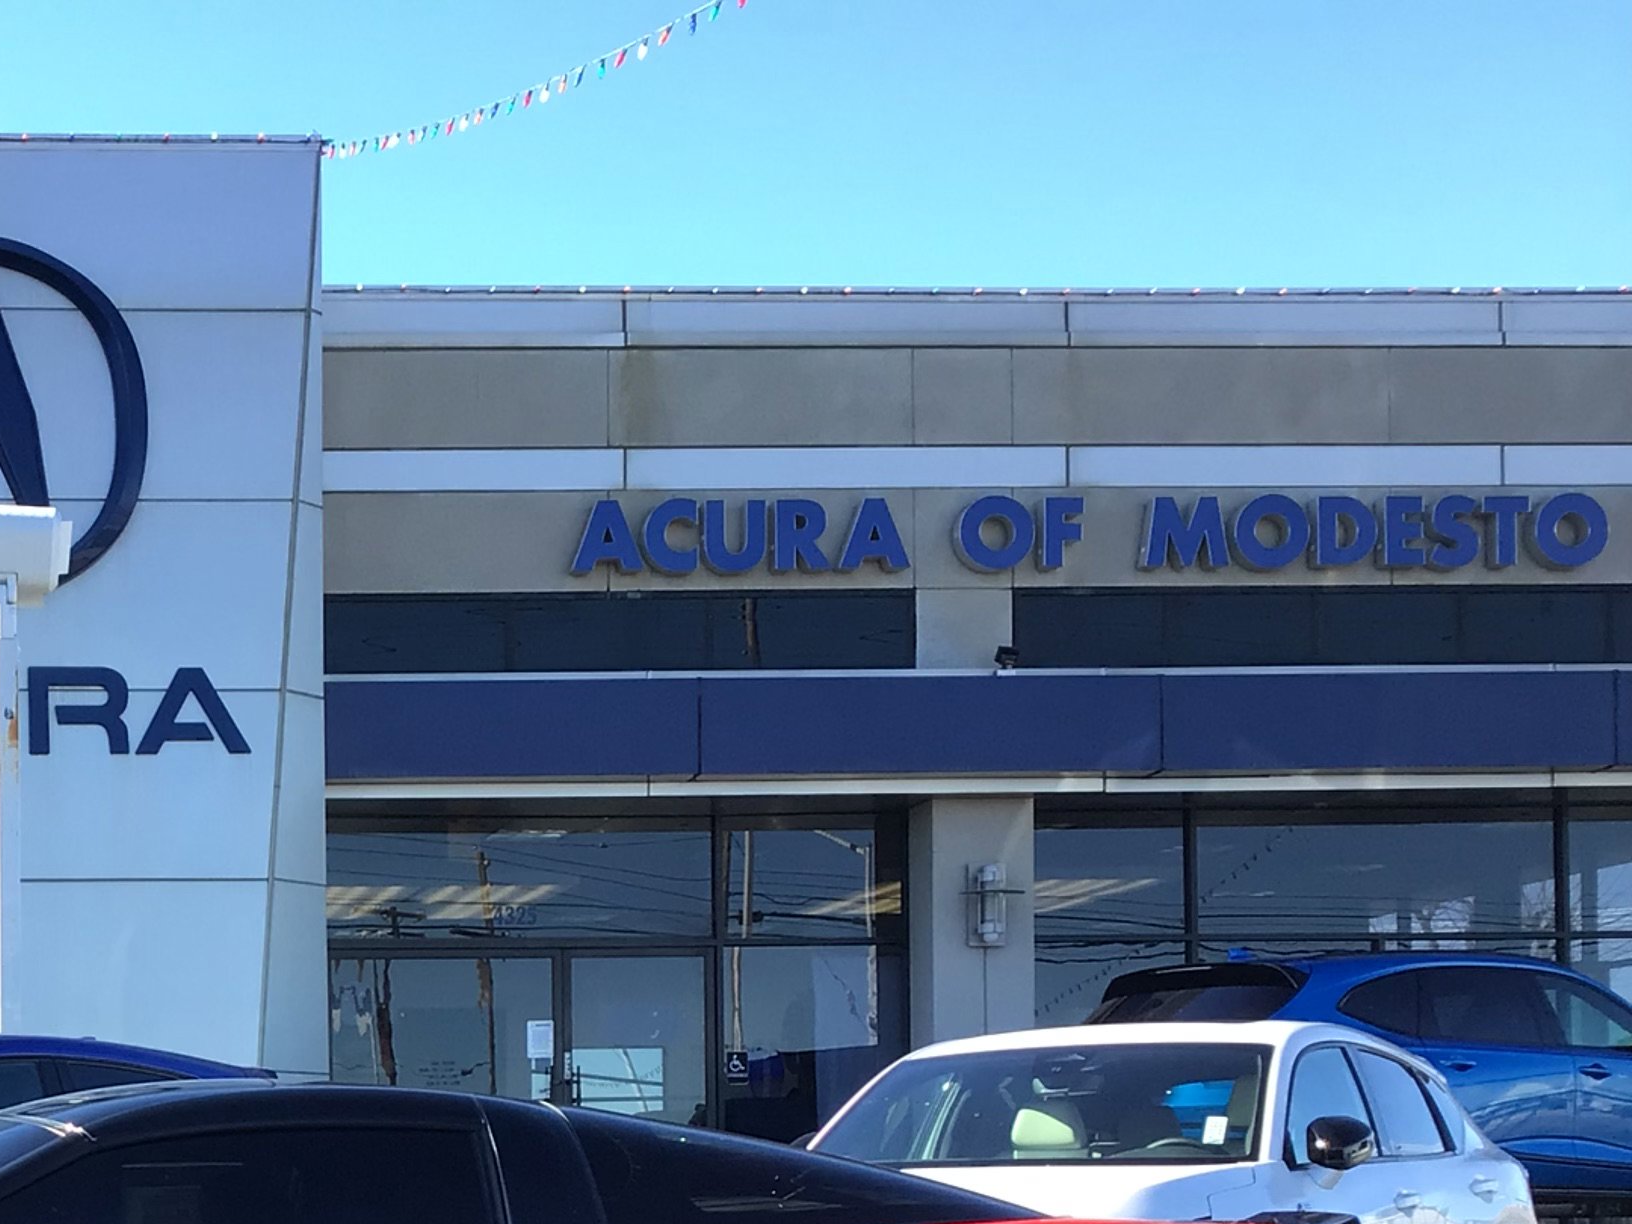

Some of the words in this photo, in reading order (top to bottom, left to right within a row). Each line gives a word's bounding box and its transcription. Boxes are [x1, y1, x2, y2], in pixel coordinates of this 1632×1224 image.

[571, 495, 911, 576] ACURA
[953, 493, 1085, 573] OF
[1138, 492, 1609, 572] MODESTO
[494, 906, 537, 924] 4325
